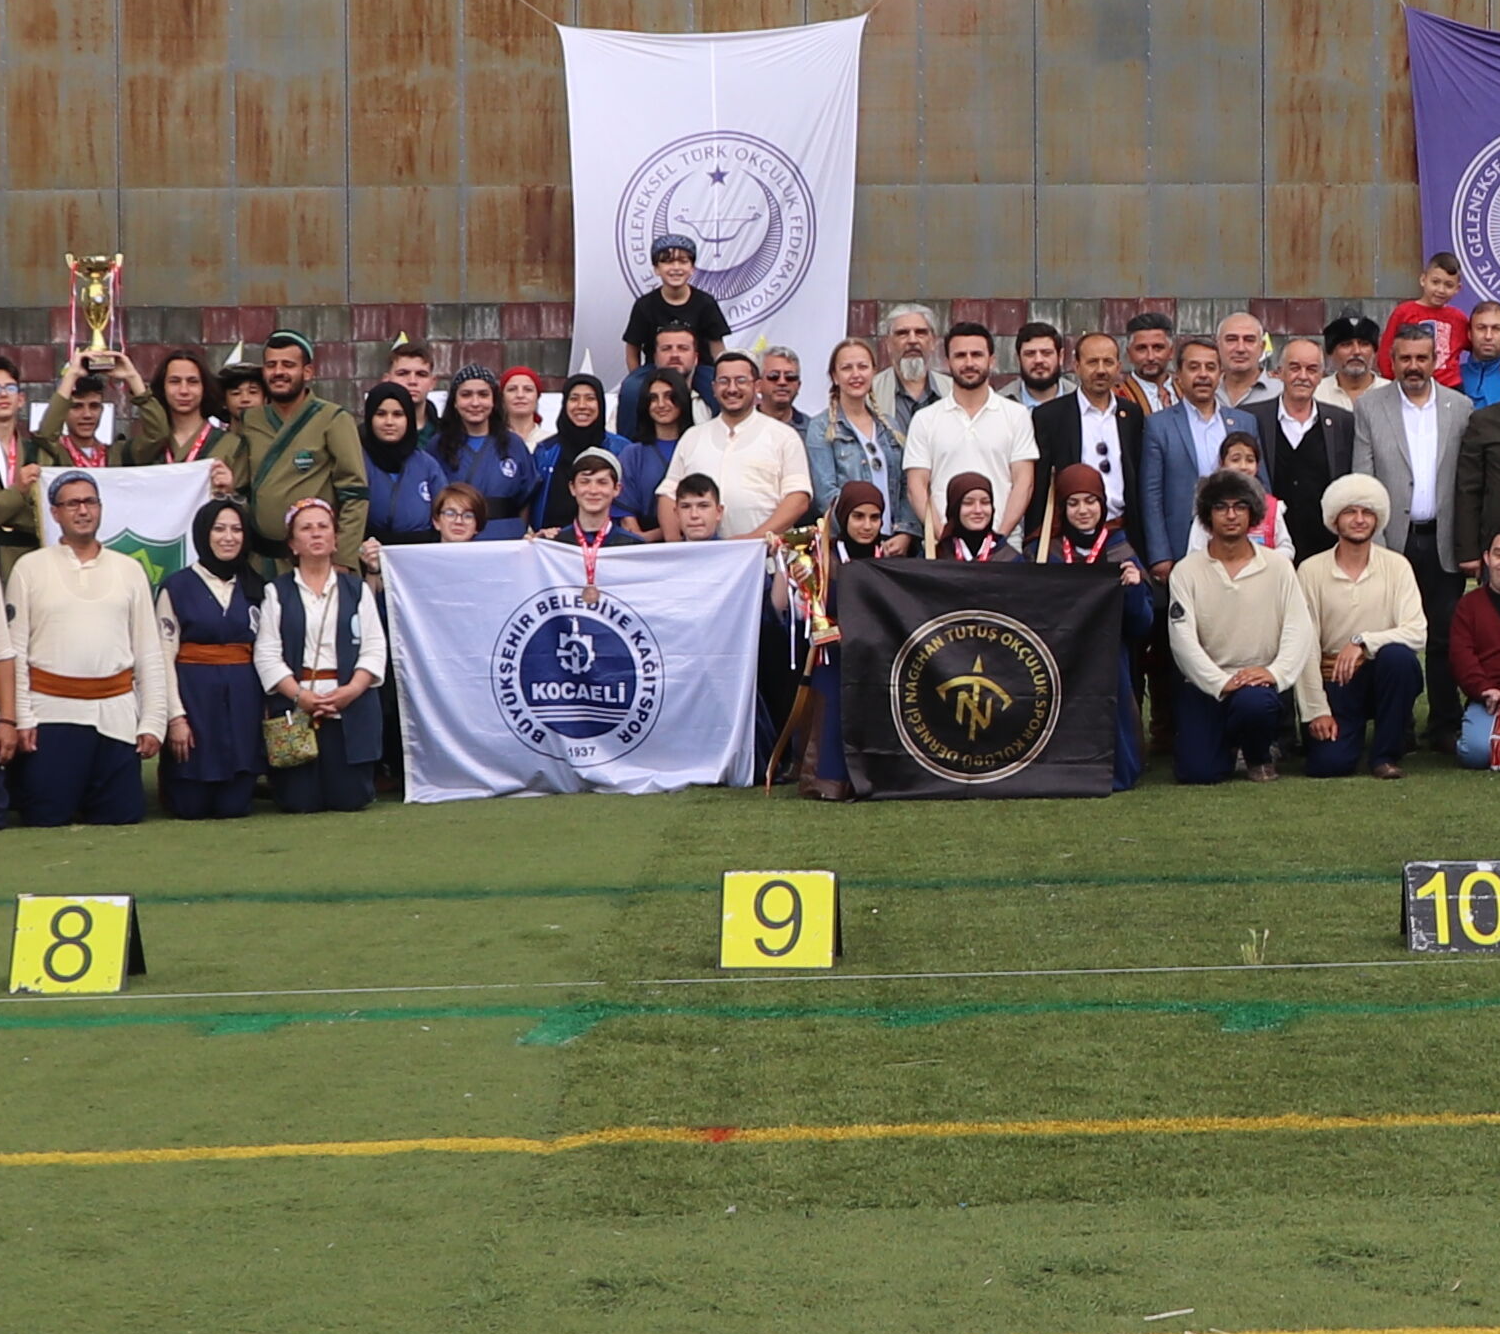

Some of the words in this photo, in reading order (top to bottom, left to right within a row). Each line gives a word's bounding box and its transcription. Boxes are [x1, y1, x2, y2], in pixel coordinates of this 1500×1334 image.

[679, 144, 728, 167] TÜRK
[734, 147, 802, 211] OKÇULUK
[631, 163, 678, 266] GELENEKSEL
[727, 214, 804, 320] FEDERASYONU
[944, 624, 999, 643] TUTUŞ
[1000, 632, 1049, 696] OKÇULUK
[500, 613, 547, 744] BÜYÜKŞEHİR
[616, 630, 660, 744] KAĞITSPOR
[531, 682, 626, 704] KOCAELİ
[904, 635, 945, 703] NAGEHAN
[568, 746, 597, 758] 1937
[1022, 700, 1047, 740] SPOR
[43, 905, 93, 983] 8
[754, 880, 803, 957] 9
